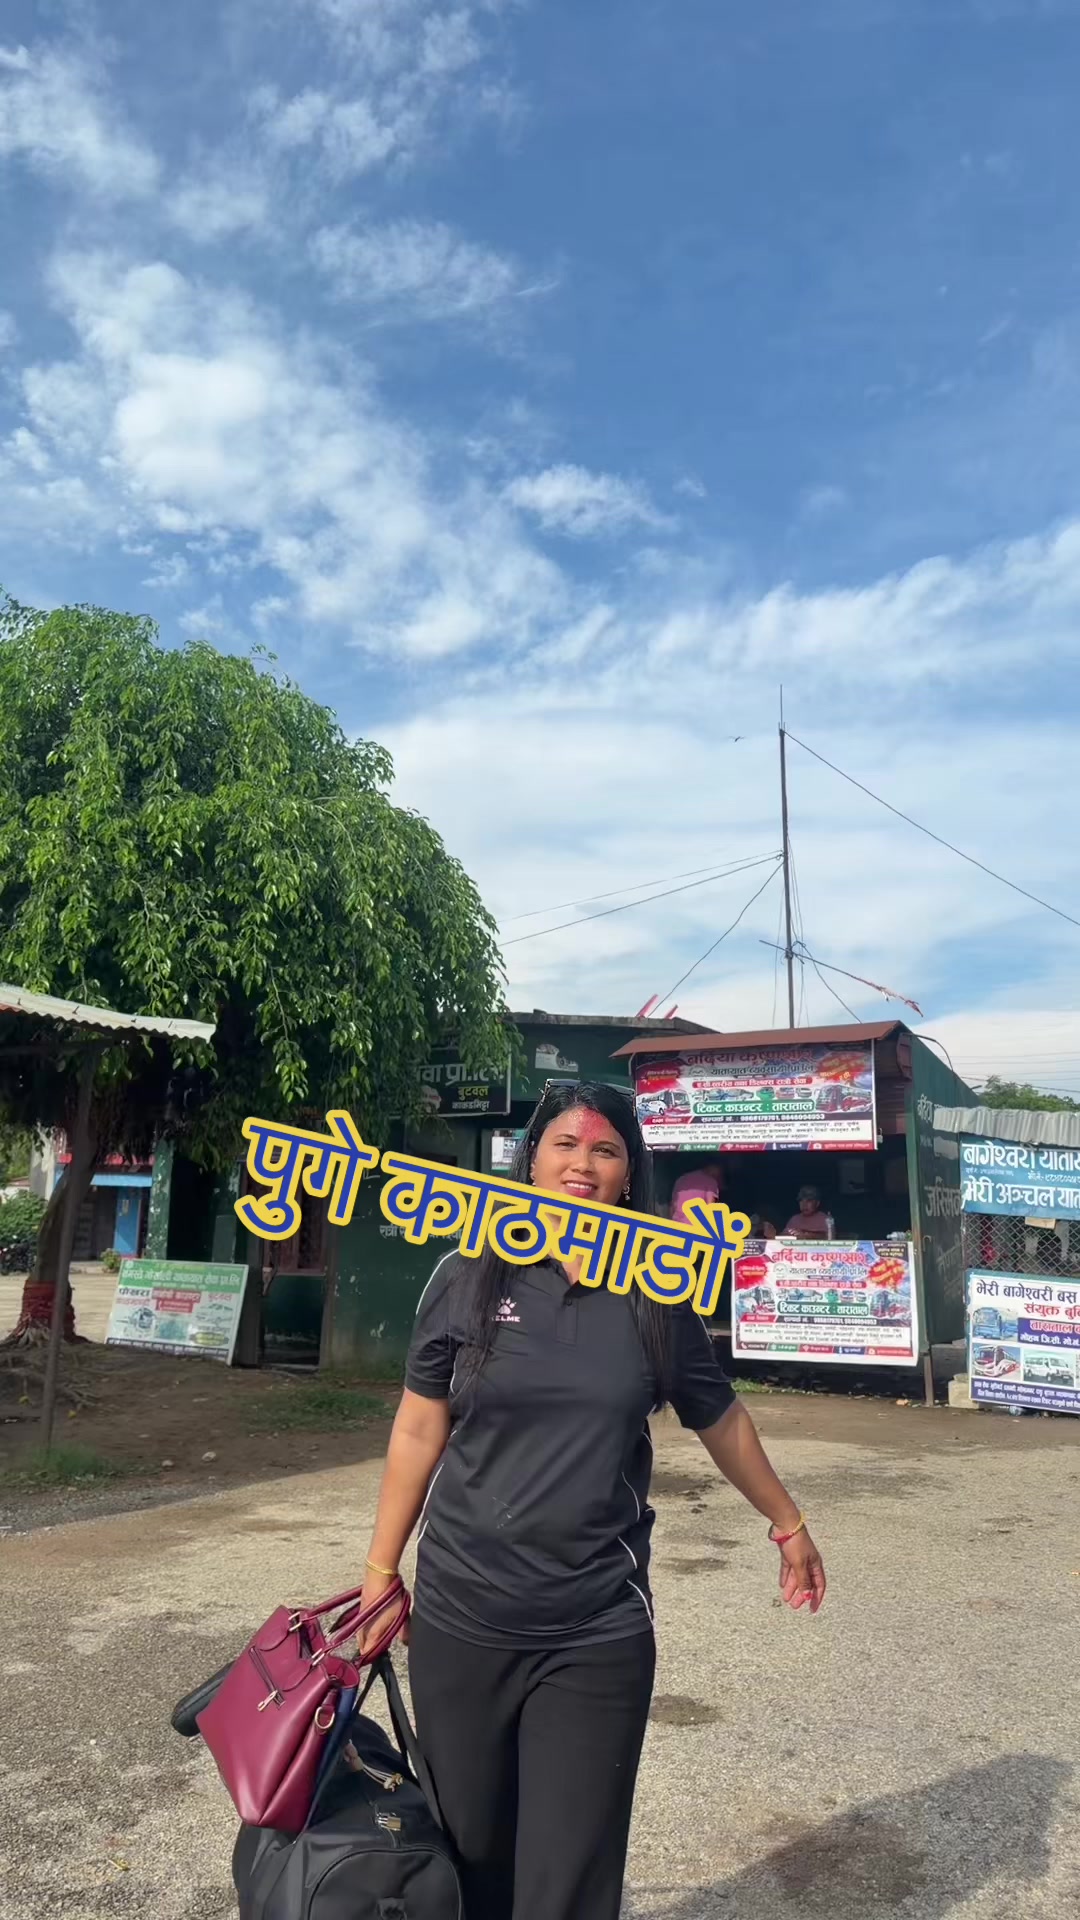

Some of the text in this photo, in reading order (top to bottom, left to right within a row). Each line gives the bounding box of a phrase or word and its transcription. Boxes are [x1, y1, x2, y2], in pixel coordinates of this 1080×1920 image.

[458, 1085, 489, 1100] बुटवल
[696, 1101, 722, 1114] टिकट
[725, 1101, 762, 1113] काउन्टर
[772, 1100, 813, 1113] ताराताल
[961, 1140, 1035, 1169] बागेश्वरी
[961, 1175, 994, 1204] भेरी
[976, 1279, 1078, 1304] भेरी बागेश्वरी बस
[779, 1302, 800, 1314] टिकट
[1024, 1302, 1061, 1317] संयुक्त
